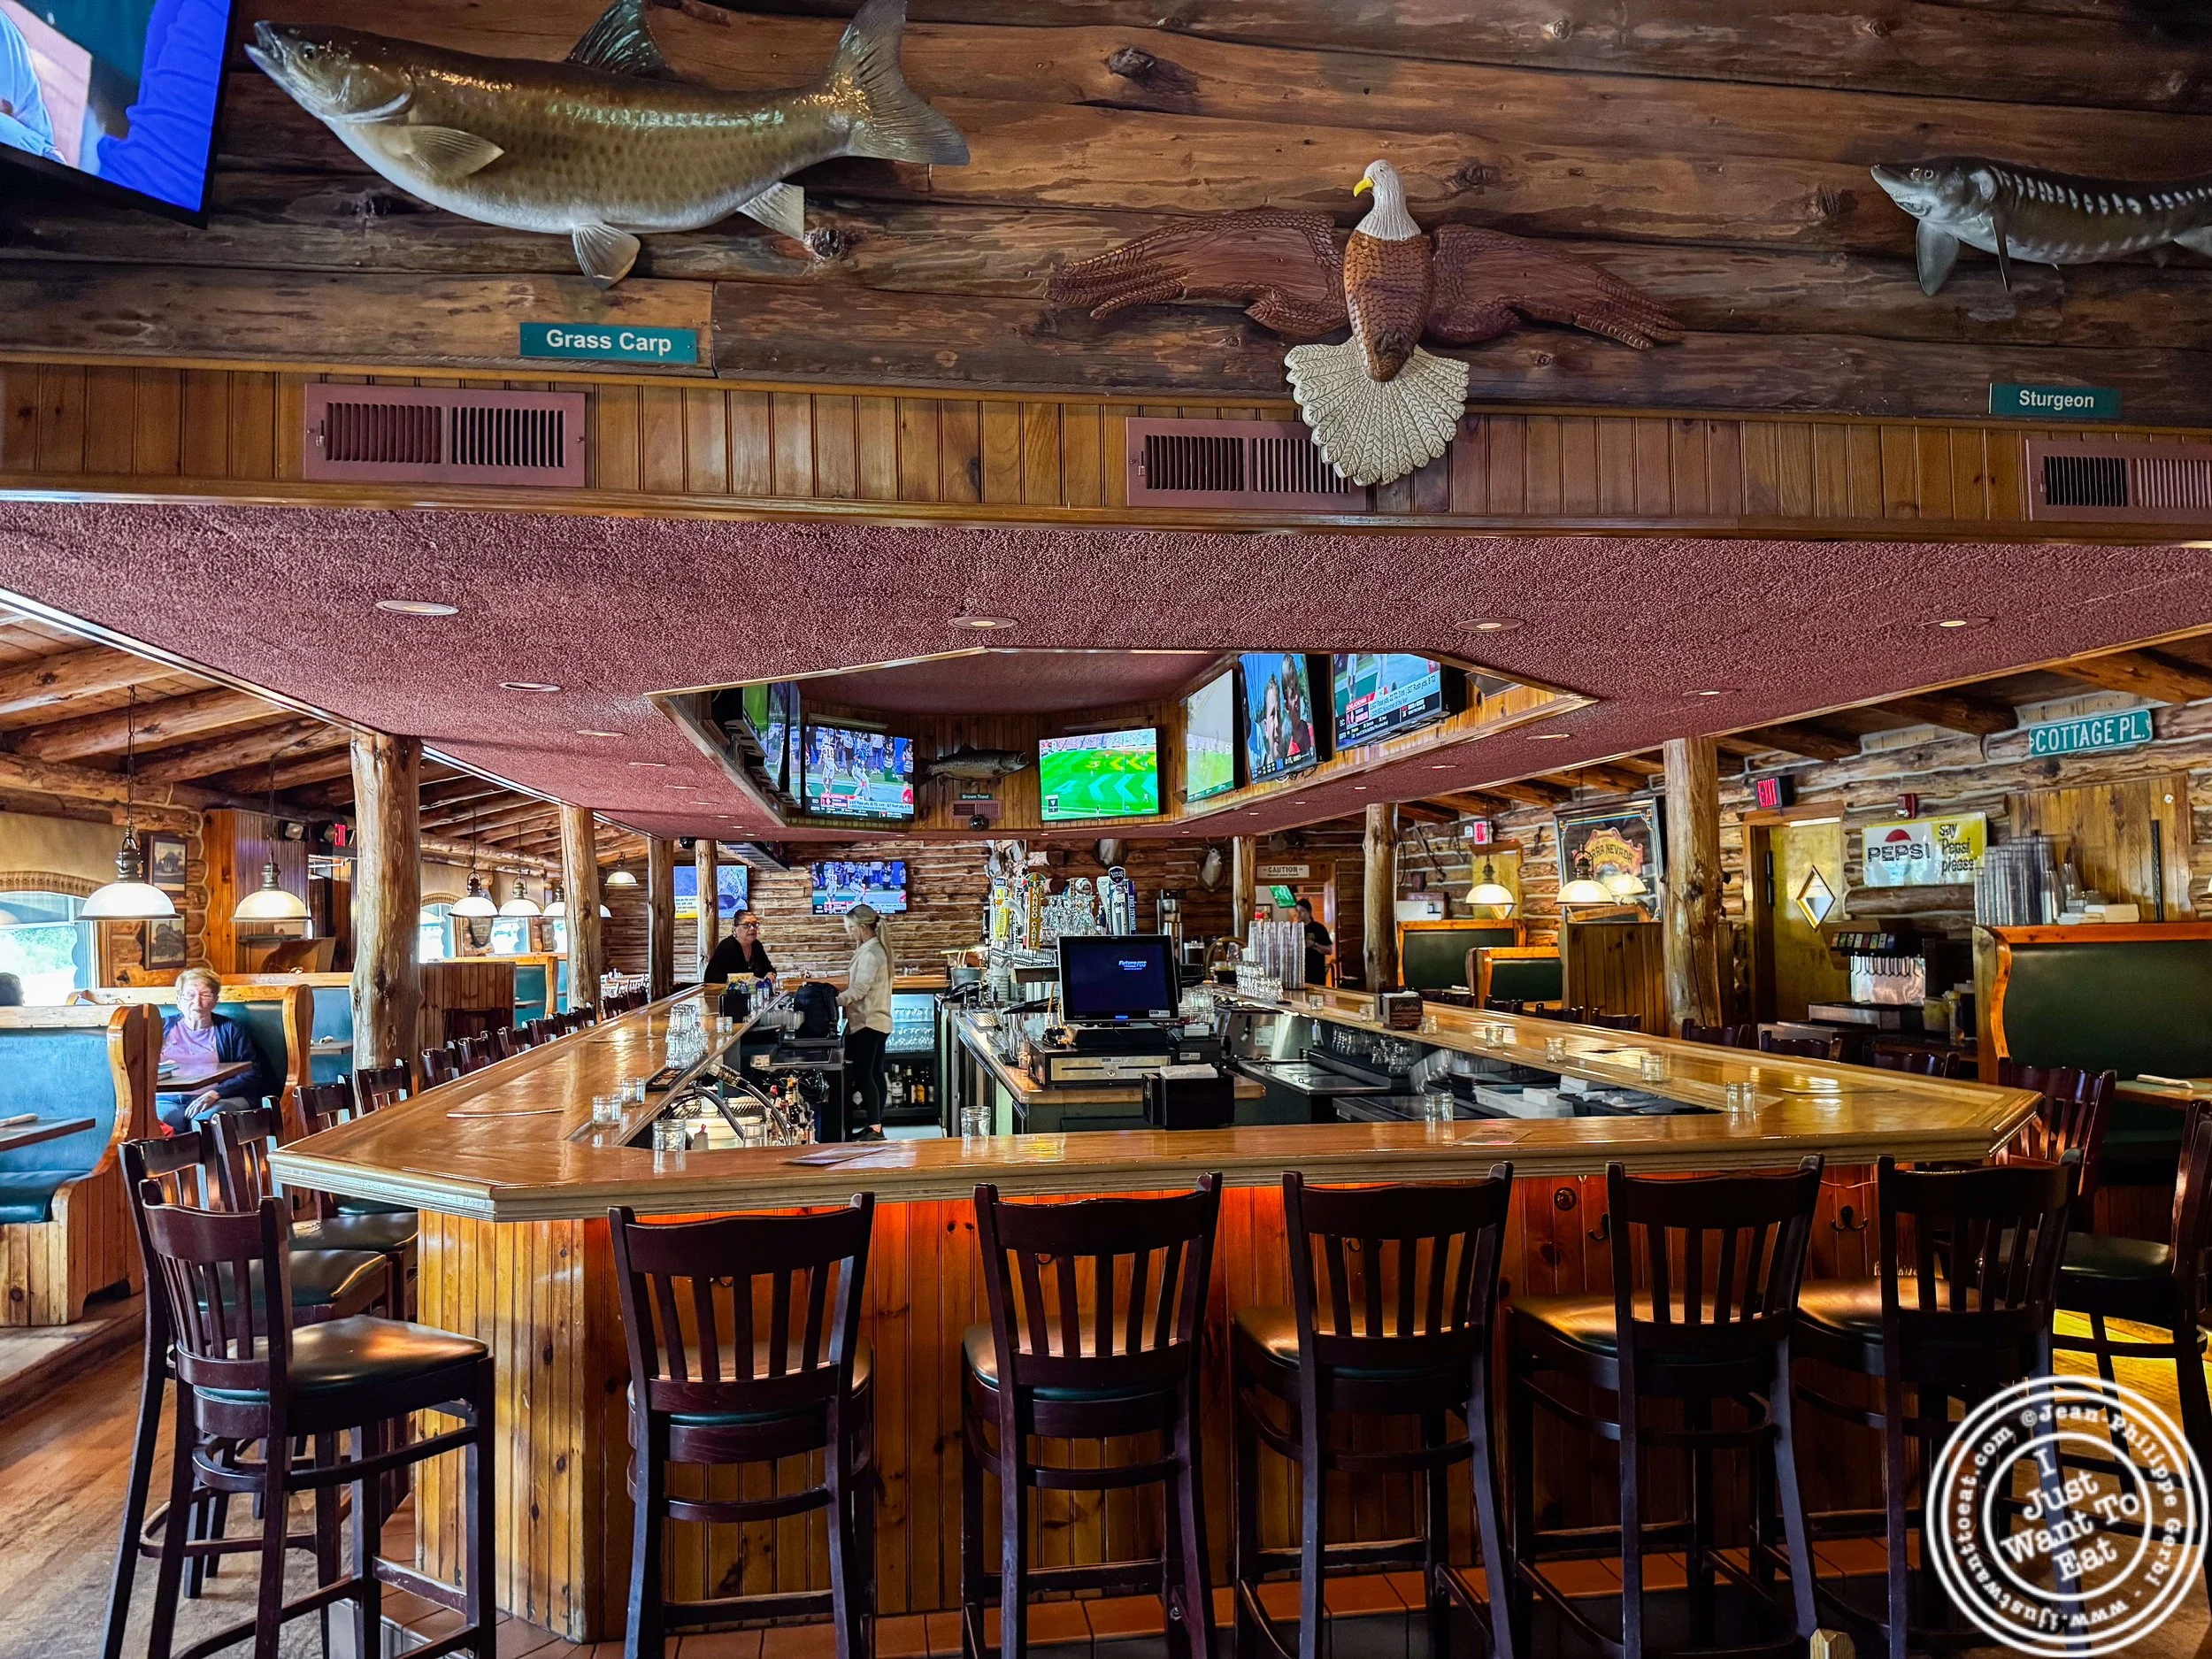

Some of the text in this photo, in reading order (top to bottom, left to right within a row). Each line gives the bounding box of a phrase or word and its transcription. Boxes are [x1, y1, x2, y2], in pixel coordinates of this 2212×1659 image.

[546, 329, 672, 357] Grass Carp
[2018, 389, 2094, 411] Sturgeon
[2035, 715, 2146, 753] COTTAGE PL.
[1757, 778, 1778, 807] EXIT
[1939, 822, 1958, 839] say
[1605, 843, 1633, 864] NEVADA
[1867, 842, 1931, 863] PEPSI
